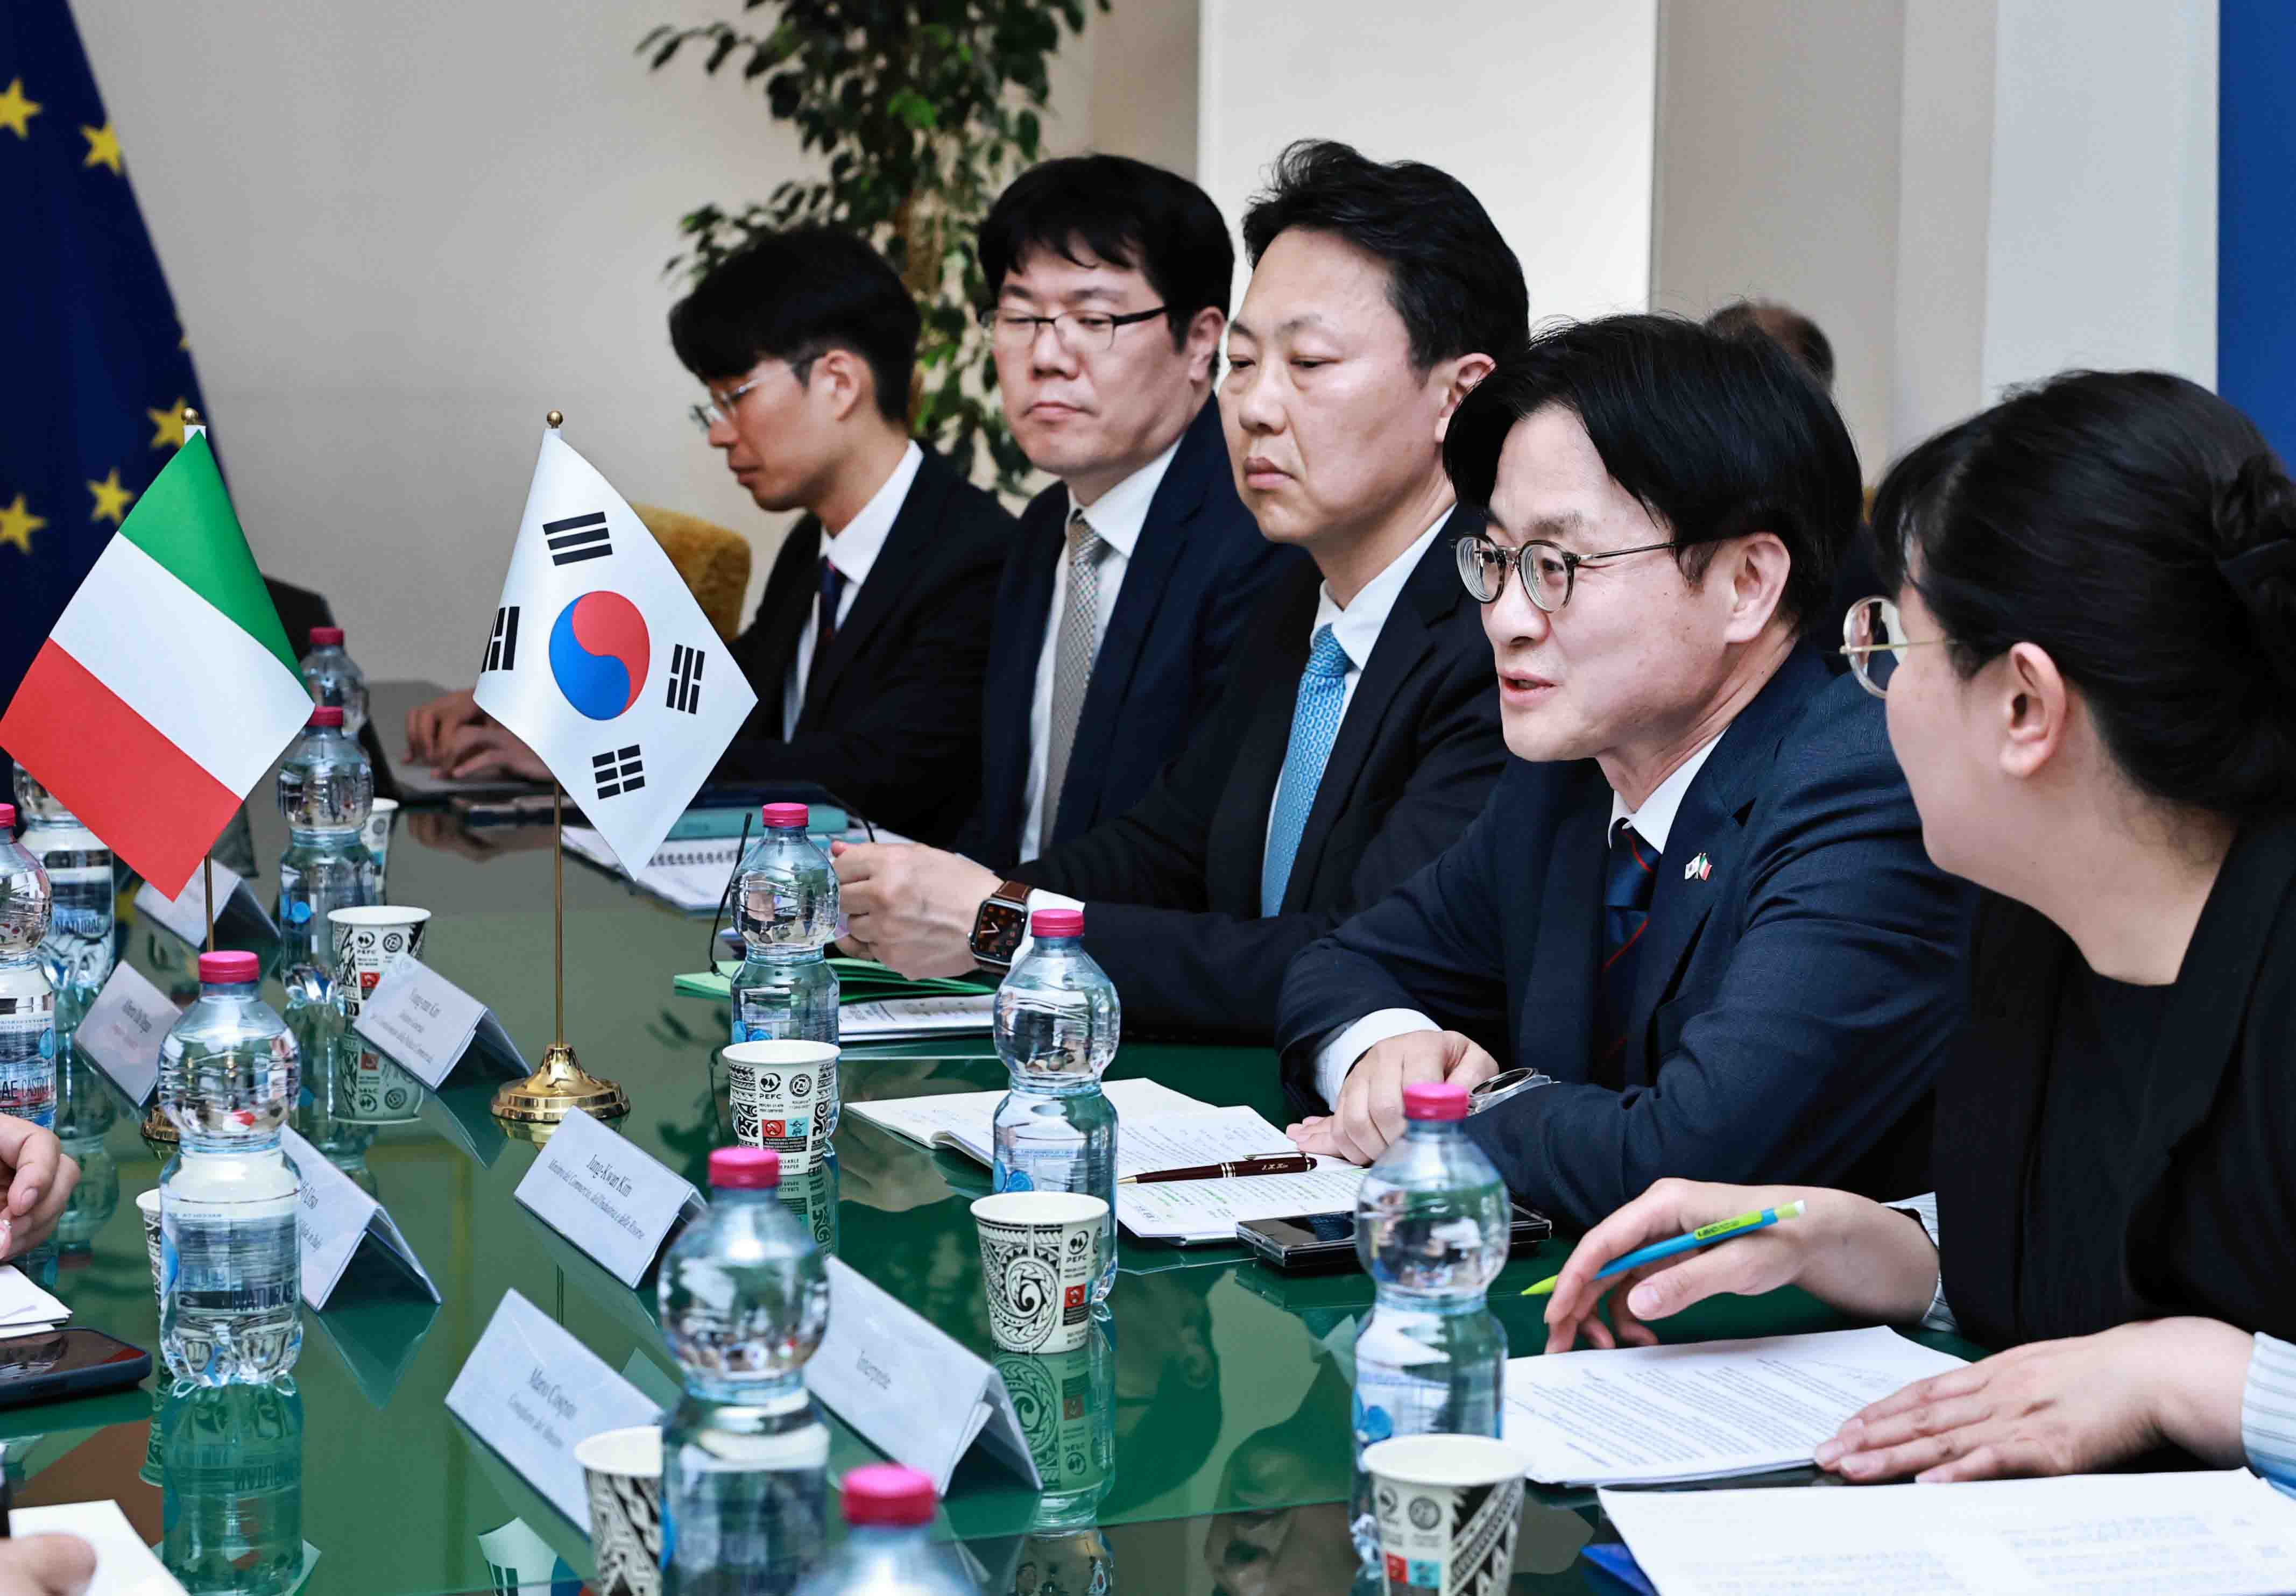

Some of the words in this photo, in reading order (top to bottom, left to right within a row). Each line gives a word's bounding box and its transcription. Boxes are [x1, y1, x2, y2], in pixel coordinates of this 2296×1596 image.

[586, 1154, 620, 1189] Jung-Kwan
[616, 1175, 632, 1197] Kim
[1065, 1254, 1087, 1264] PEFC
